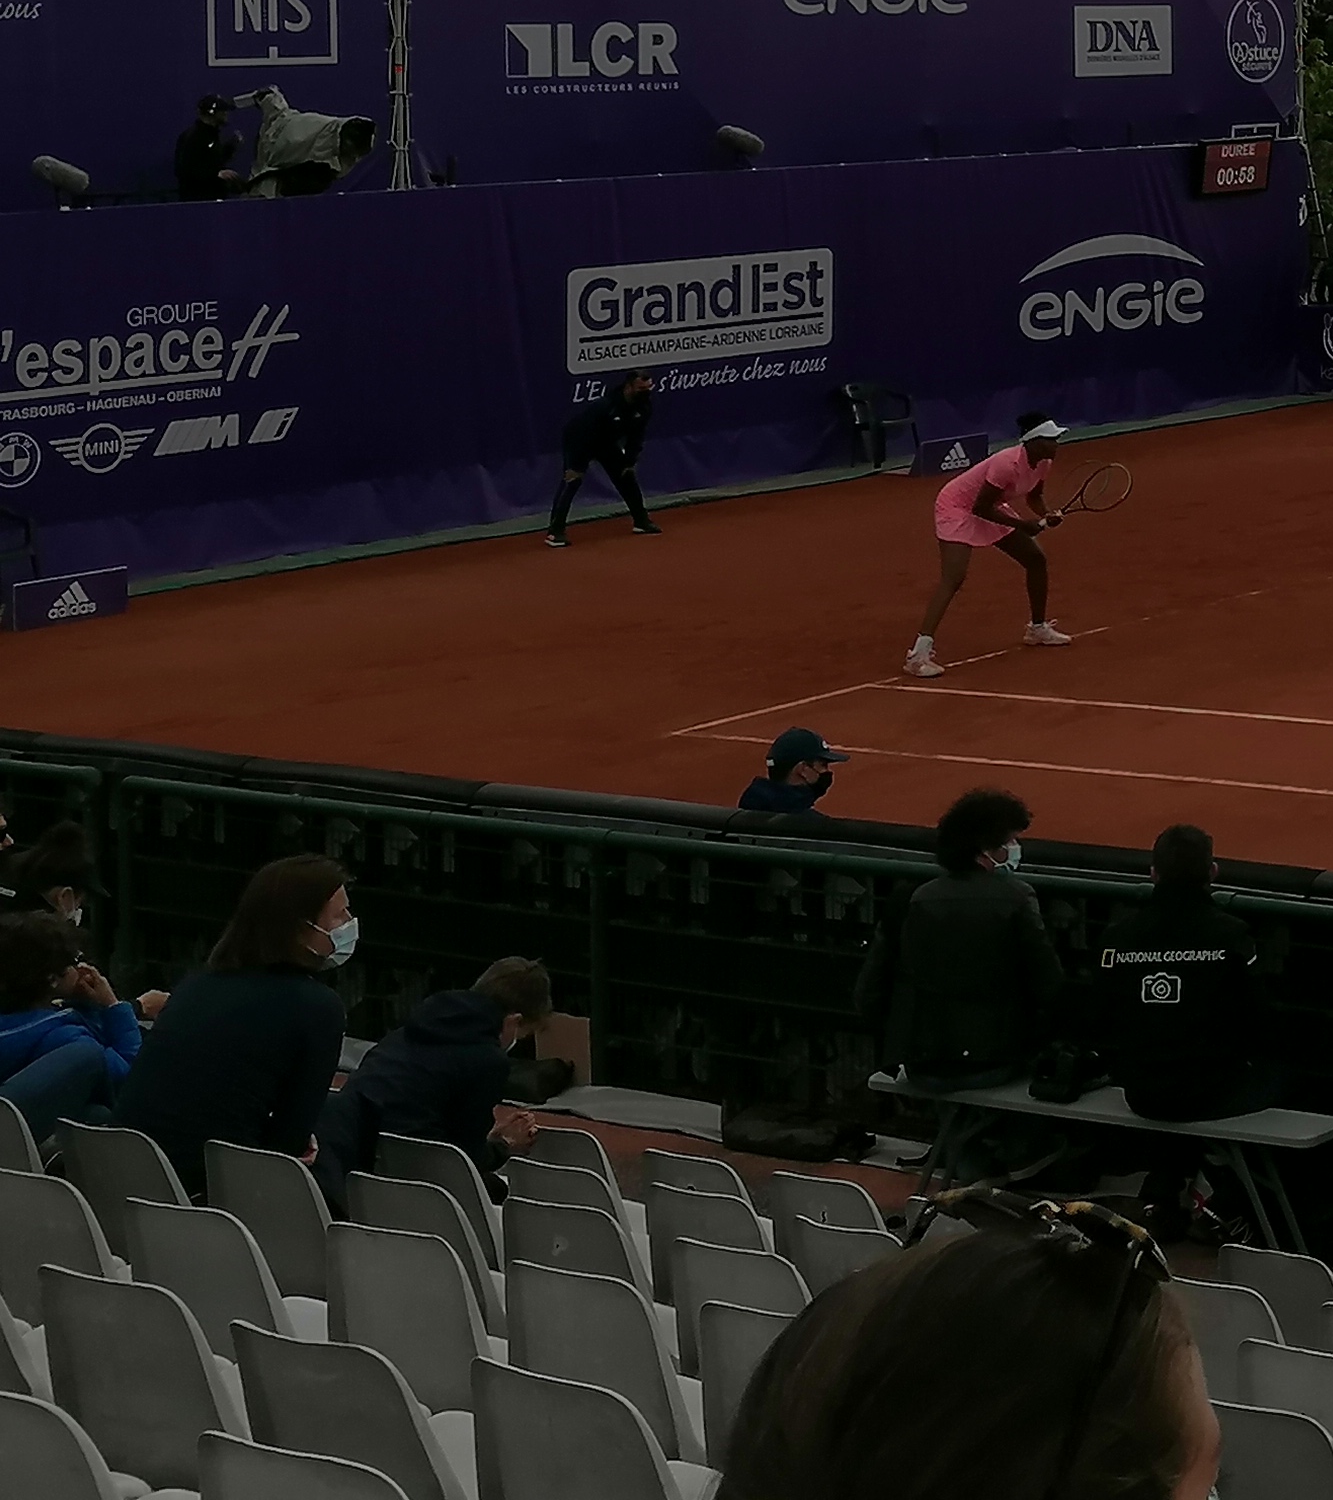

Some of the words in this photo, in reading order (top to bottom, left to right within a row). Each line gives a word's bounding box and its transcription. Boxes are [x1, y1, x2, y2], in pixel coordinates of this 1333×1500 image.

[1087, 20, 1160, 52] DNA
[505, 85, 528, 95] LES
[533, 82, 634, 94] CONSTRUCTEURS
[1216, 165, 1256, 186] 00:58
[126, 300, 219, 328] GROUPE
[577, 344, 628, 363] ALSACE
[629, 327, 768, 356] CHAMPAGNE-ARDENNE
[769, 322, 825, 341] LORRAINE
[741, 357, 786, 381] chez
[788, 356, 829, 375] nous
[87, 392, 157, 413] HAGUENAU
[167, 385, 222, 403] OBERNAI
[84, 438, 120, 457] MINI
[940, 458, 971, 470] adidas
[47, 601, 97, 619] adidas
[1116, 951, 1162, 963] NATIONAL
[1163, 949, 1226, 962] GEOGRAPHIC
